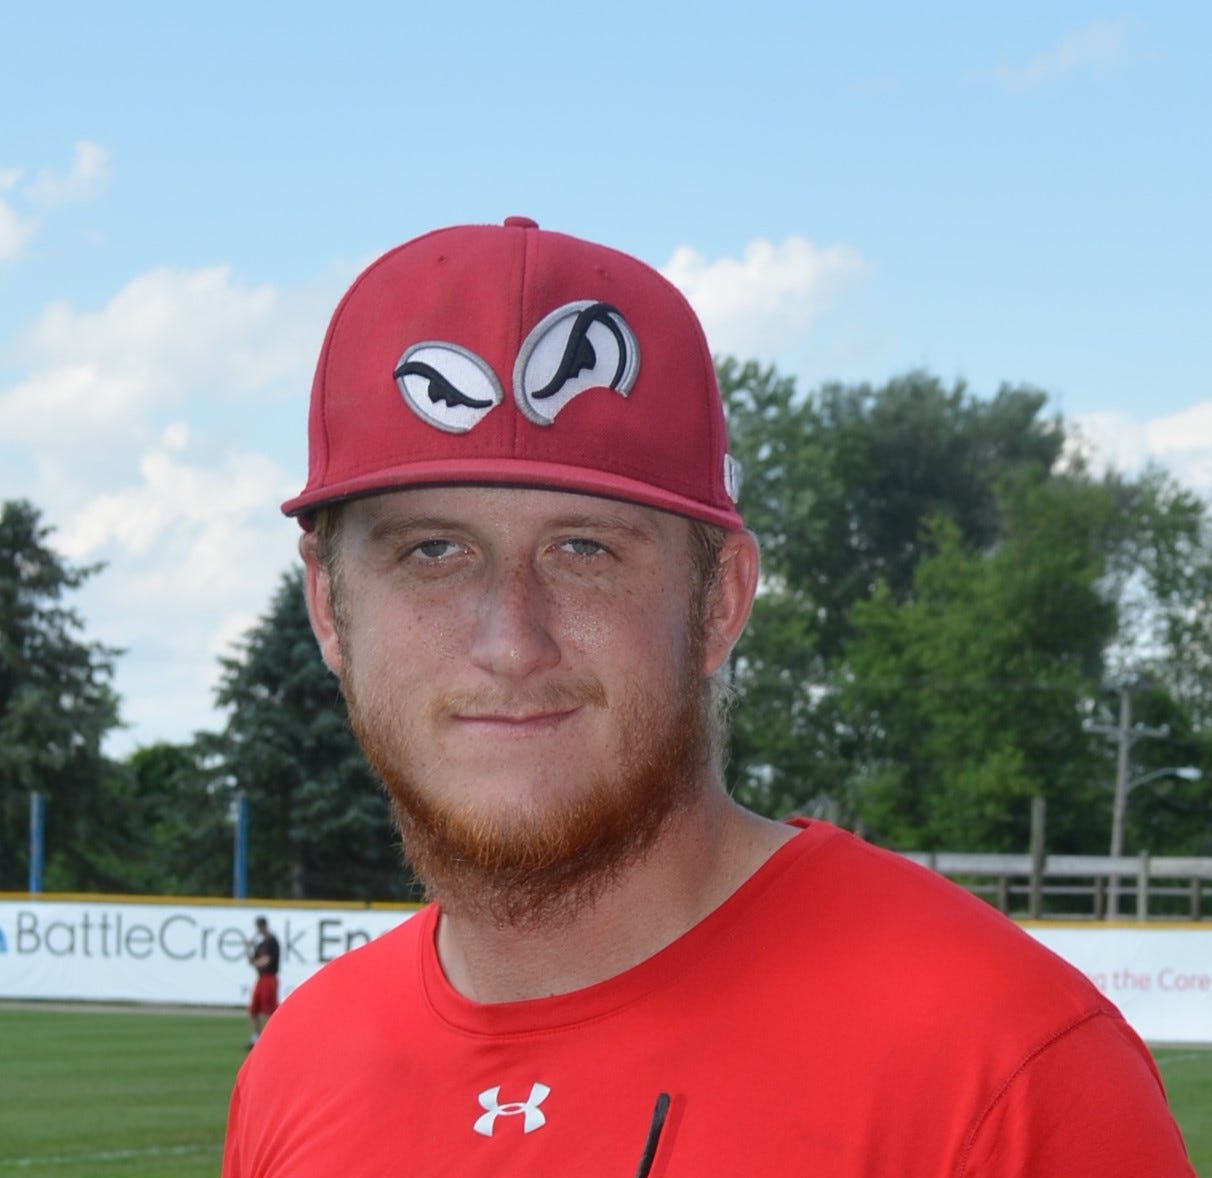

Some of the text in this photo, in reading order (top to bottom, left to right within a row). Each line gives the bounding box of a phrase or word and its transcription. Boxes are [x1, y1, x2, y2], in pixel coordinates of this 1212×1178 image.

[16, 910, 306, 965] BattleCrek
[1112, 967, 1151, 992] the
[1157, 966, 1212, 992] Core
